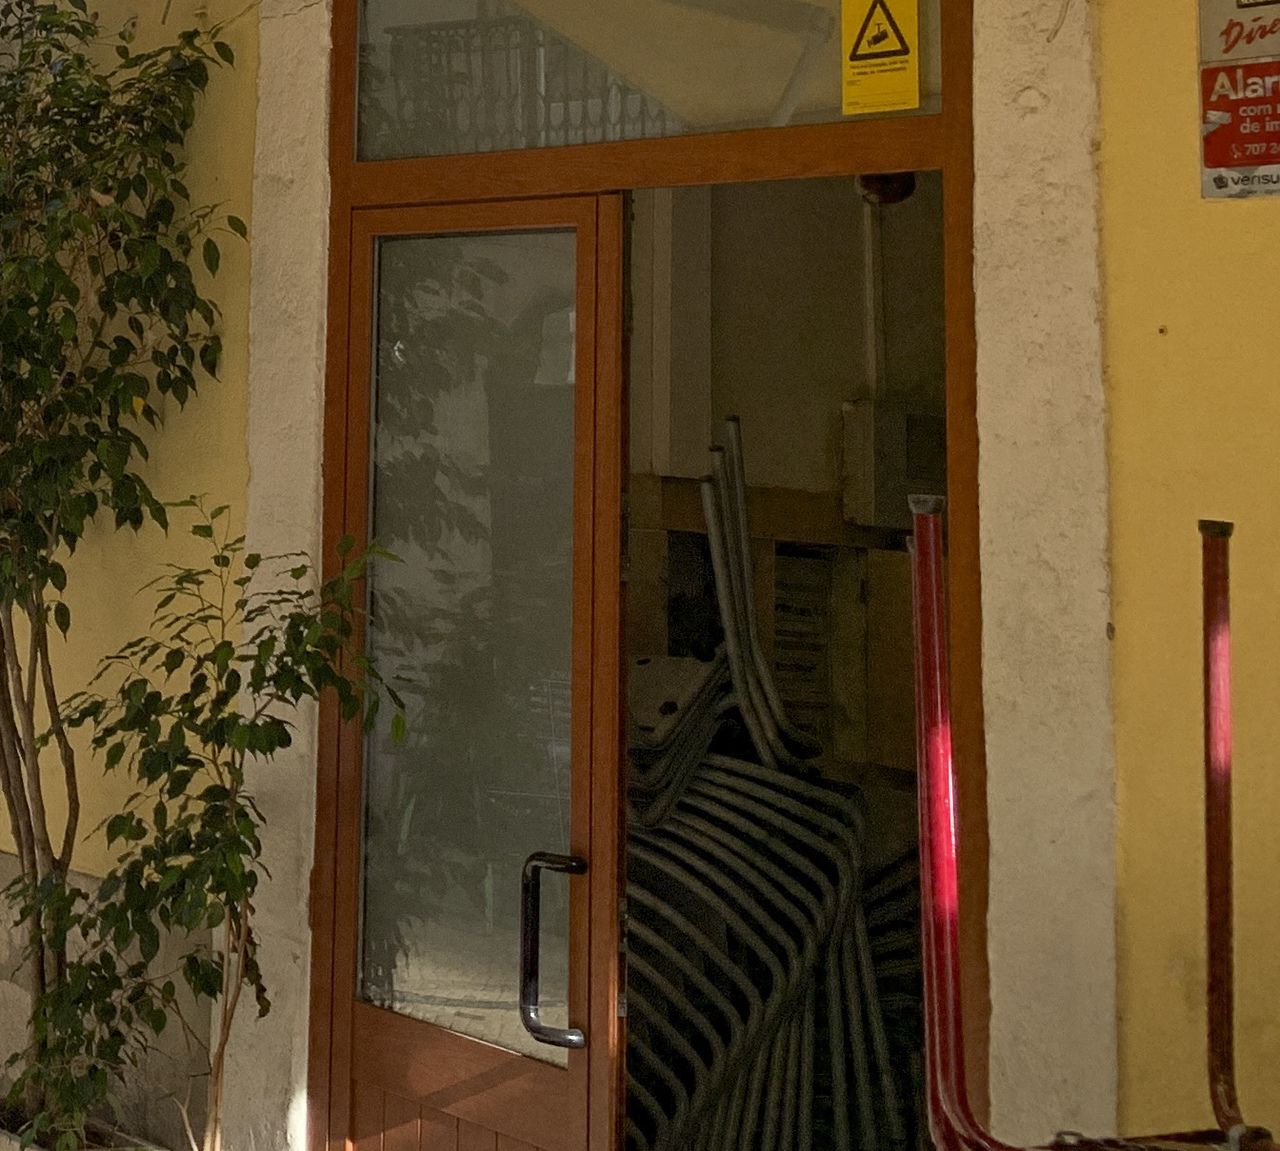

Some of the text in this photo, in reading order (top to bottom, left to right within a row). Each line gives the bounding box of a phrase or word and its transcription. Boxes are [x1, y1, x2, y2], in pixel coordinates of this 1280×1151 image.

[1239, 104, 1273, 117] com
[1240, 117, 1261, 134] de
[1244, 142, 1268, 156] 707
